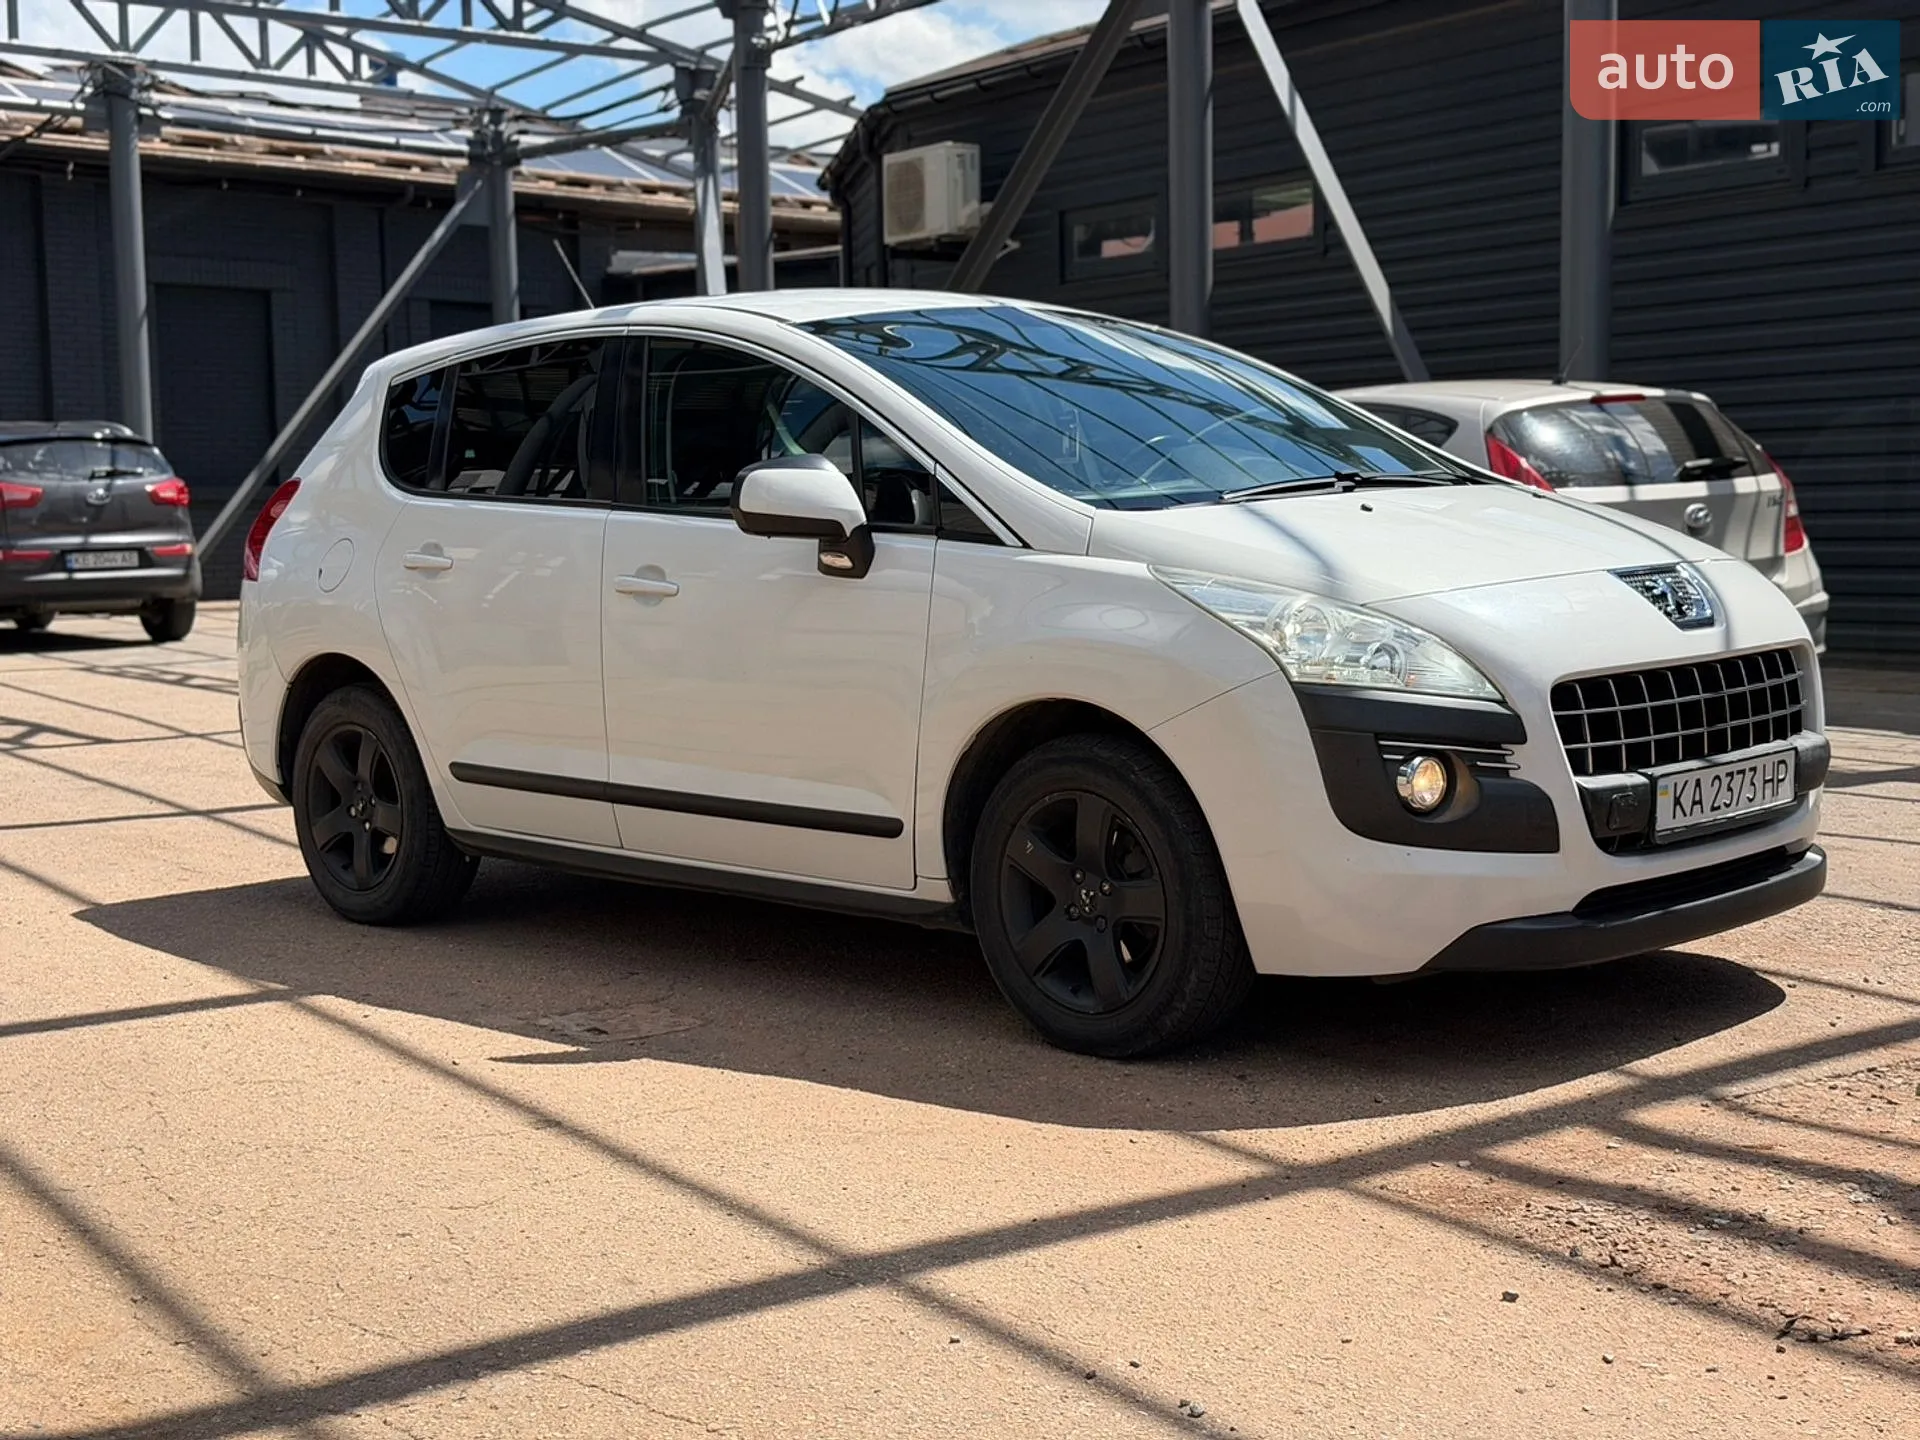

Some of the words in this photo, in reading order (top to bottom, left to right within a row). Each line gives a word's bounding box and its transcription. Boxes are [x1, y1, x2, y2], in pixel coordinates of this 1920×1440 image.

[1672, 778, 1704, 820] KA
[1710, 766, 1757, 812] 2373
[1762, 759, 1788, 800] HP
